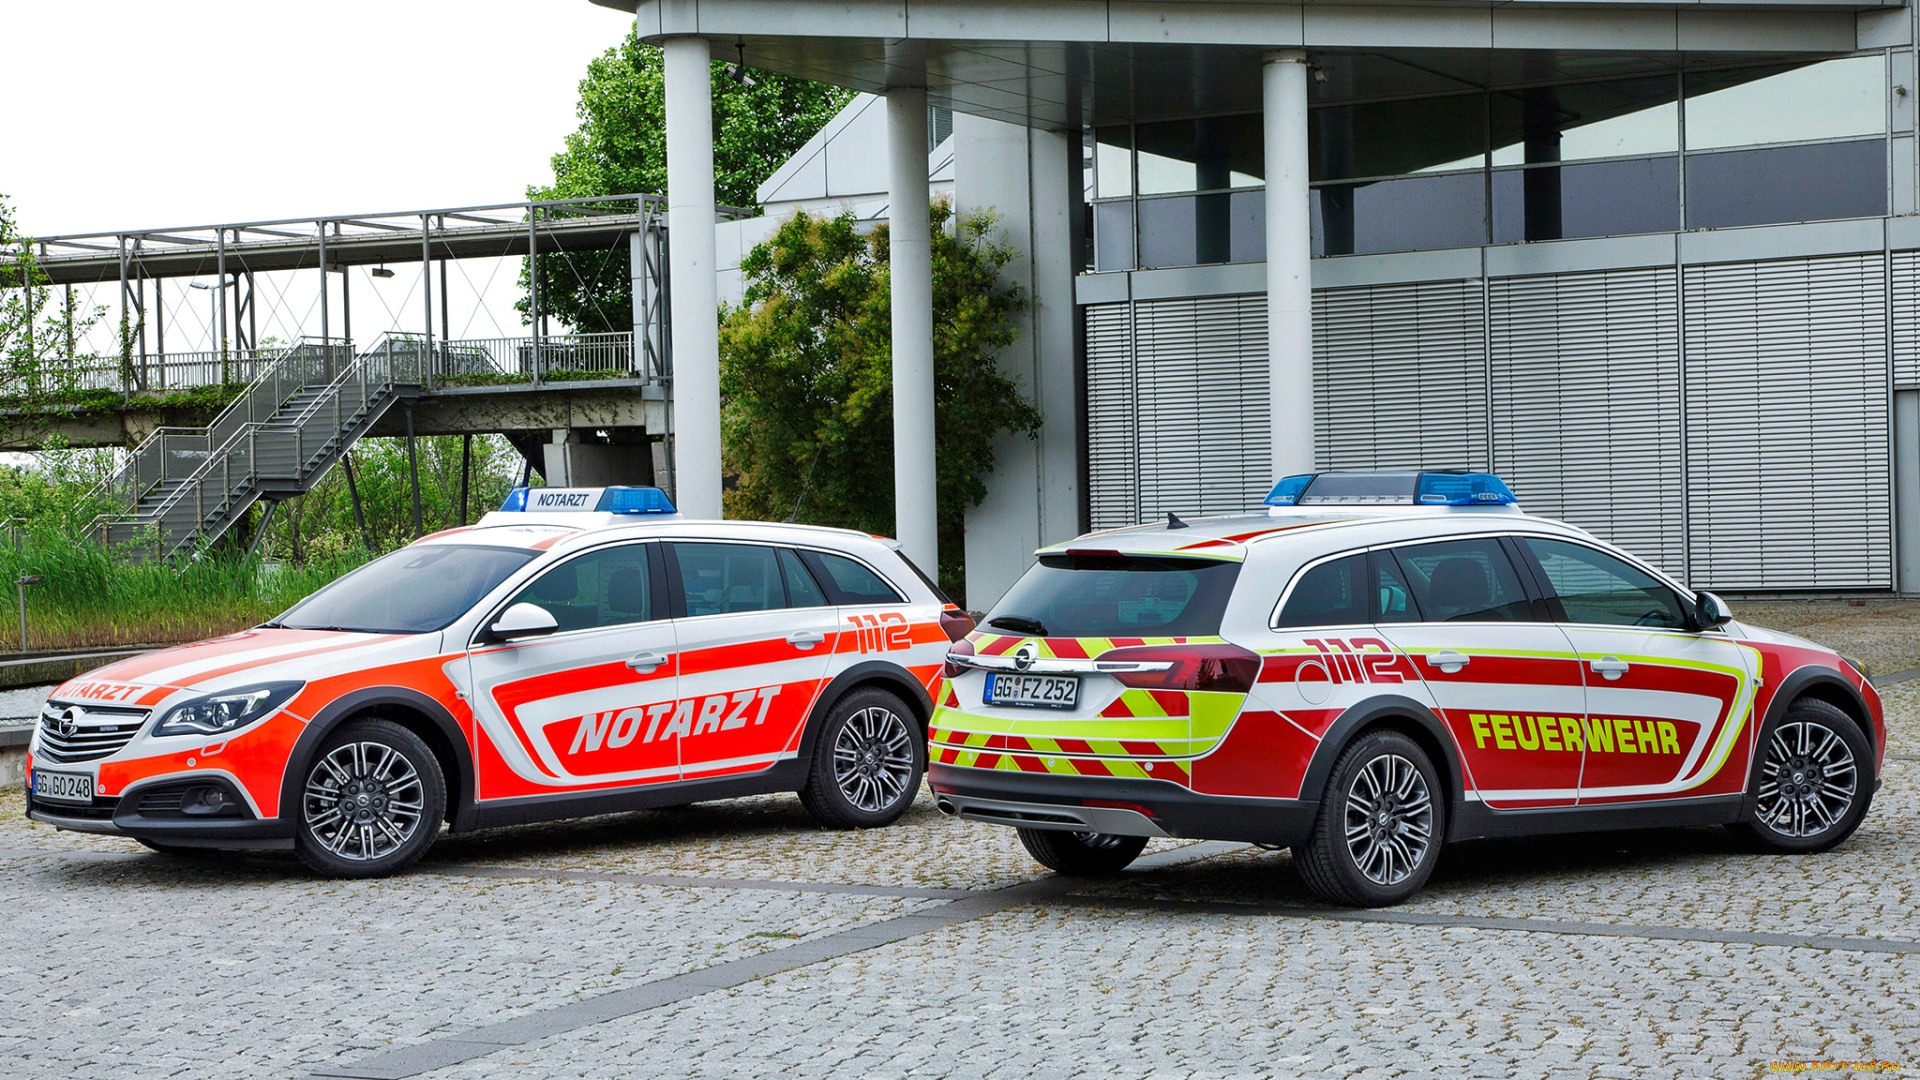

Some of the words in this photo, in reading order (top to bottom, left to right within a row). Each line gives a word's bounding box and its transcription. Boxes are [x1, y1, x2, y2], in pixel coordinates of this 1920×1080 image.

[537, 493, 590, 507] NOTARZT
[846, 612, 912, 655] 112
[1302, 637, 1404, 685] 112
[56, 681, 143, 701] NOTARZT
[993, 677, 1013, 698] GG
[1020, 677, 1042, 699] FZ
[1043, 679, 1076, 702] 252
[567, 684, 783, 756] NOTARZT
[1468, 713, 1682, 755] FEUERWEHR
[36, 773, 48, 794] GG
[53, 776, 65, 796] GO
[68, 777, 91, 798] 248
